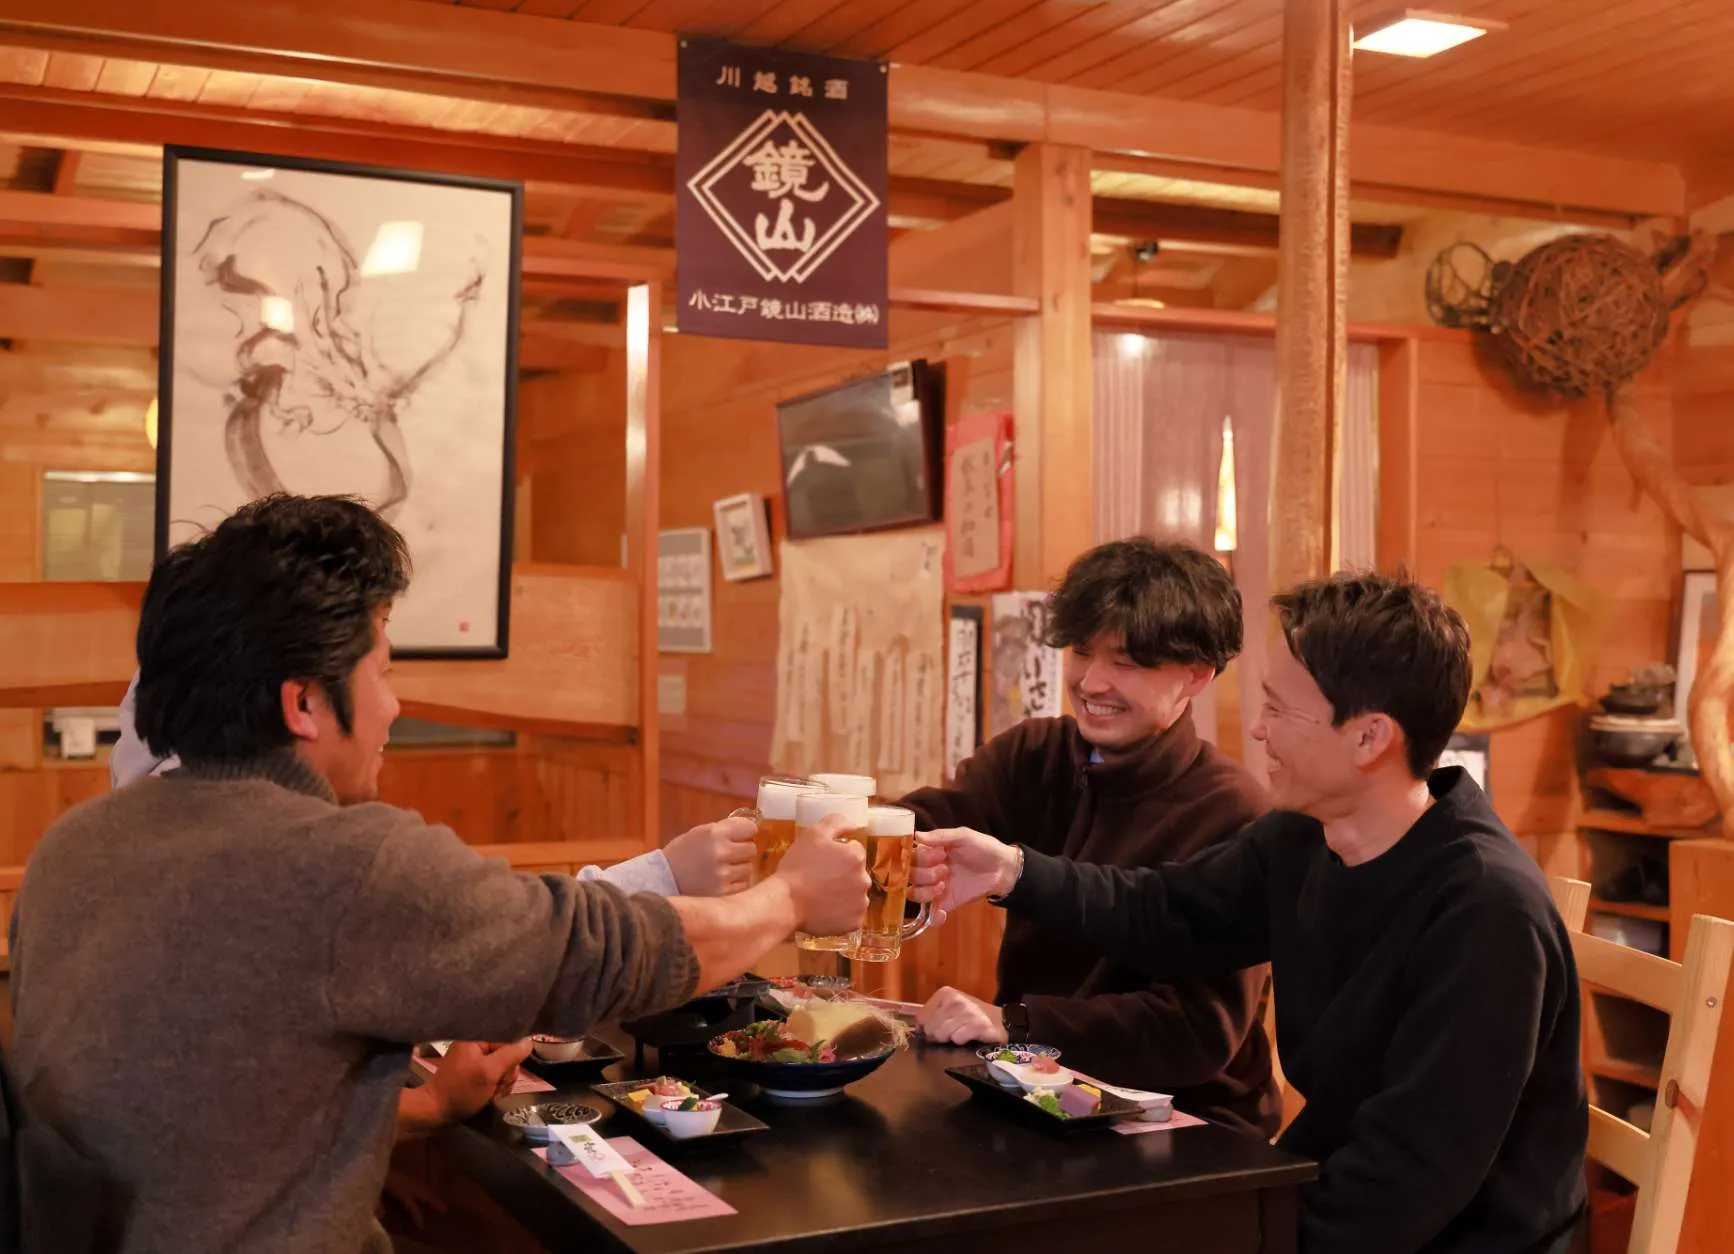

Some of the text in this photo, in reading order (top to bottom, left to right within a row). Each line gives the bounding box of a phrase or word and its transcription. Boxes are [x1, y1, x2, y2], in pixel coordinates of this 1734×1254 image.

[716, 65, 848, 100] 川越銘酒
[743, 140, 829, 252] 鏡山
